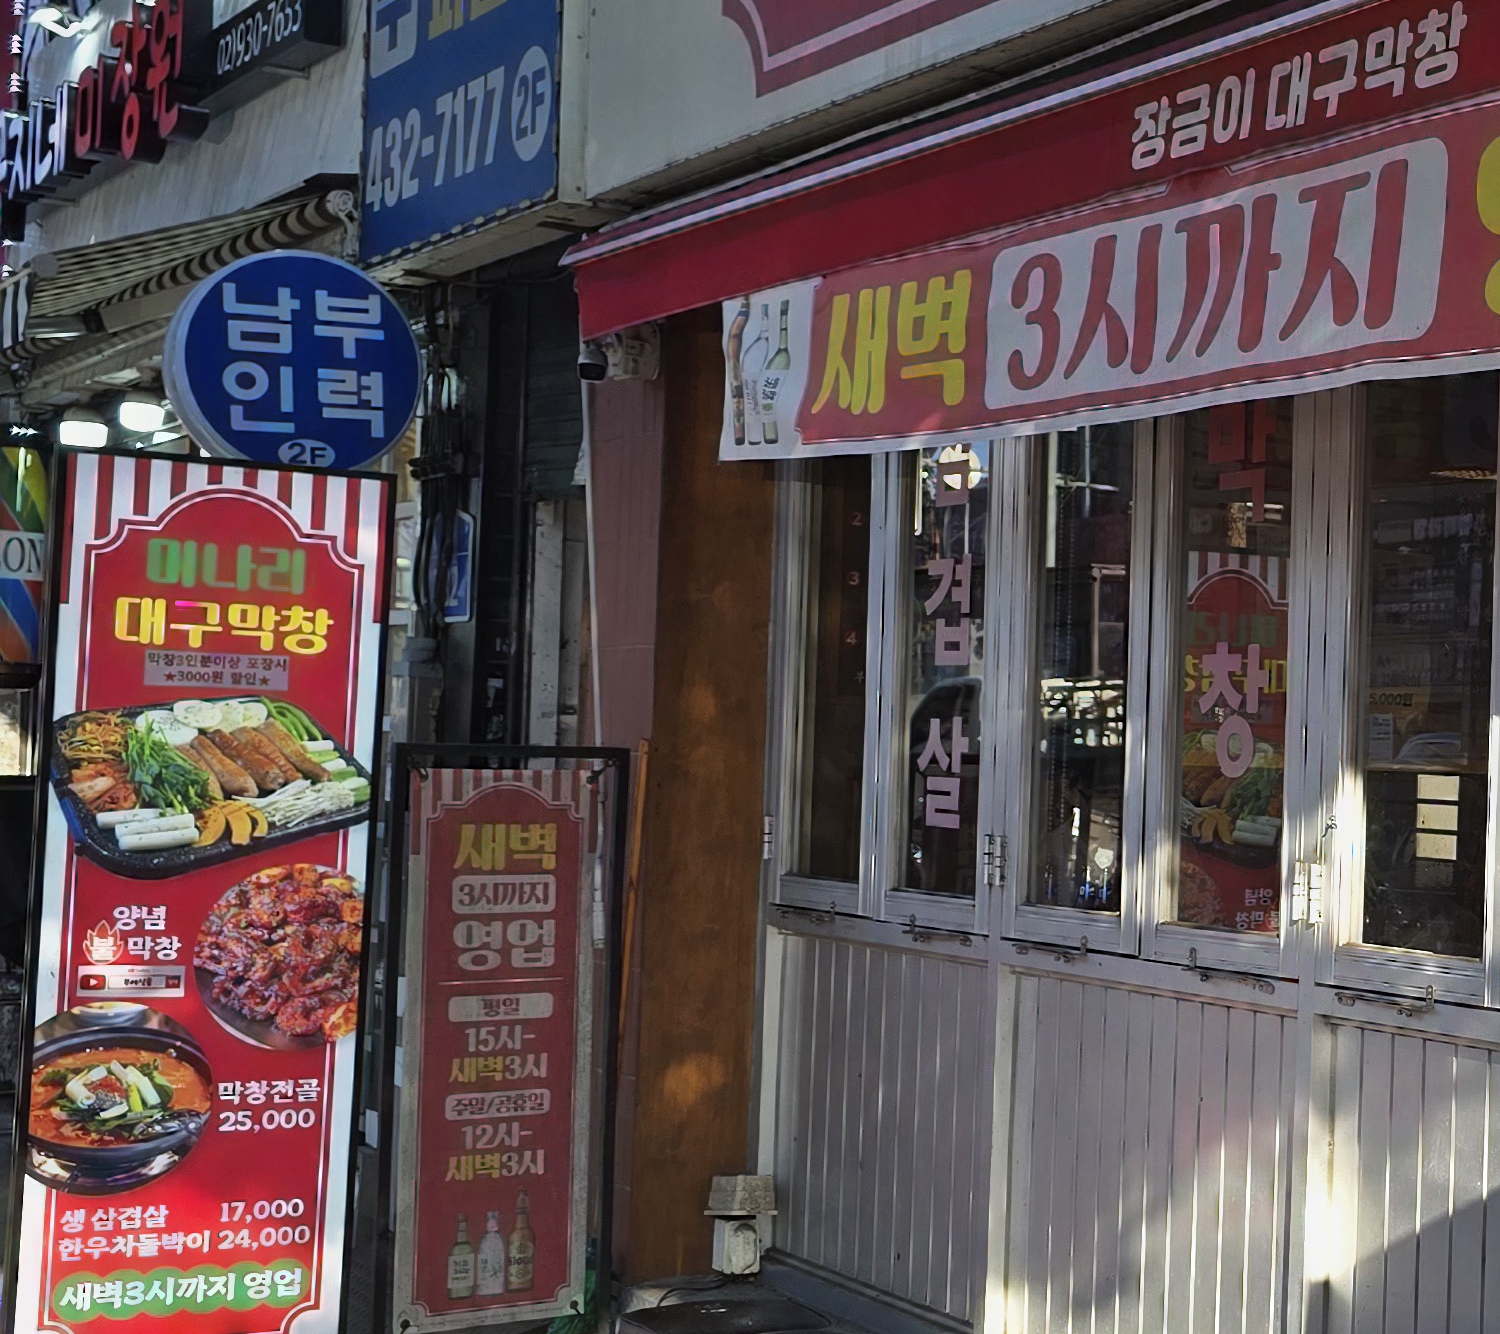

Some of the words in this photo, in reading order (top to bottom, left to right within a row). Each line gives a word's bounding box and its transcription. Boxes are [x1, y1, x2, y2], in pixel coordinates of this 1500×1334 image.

[1130, 67, 1256, 171] 장금이
[1265, 0, 1468, 131] 대구막창
[363, 65, 505, 213] 432-7177
[513, 68, 549, 140] 2F
[810, 268, 973, 416] 새벽
[1004, 156, 1411, 393] 3시까지
[222, 281, 386, 359] 남부
[221, 359, 386, 439] 인력
[286, 443, 328, 465] 2F
[146, 537, 308, 596] 미나리
[114, 595, 335, 656] 대구막창
[177, 670, 225, 685] 3000원
[230, 671, 258, 687] 할인
[453, 822, 557, 871] 새벽
[458, 881, 550, 907] 3시까지
[112, 905, 166, 931] 양념
[88, 936, 119, 960] 불
[126, 935, 182, 961] 막창
[452, 919, 556, 971] 영업
[481, 996, 521, 1017] 평일
[465, 1024, 537, 1052] 15시-
[448, 1052, 549, 1084] 새벽3시
[217, 1078, 321, 1105] 막창전골
[450, 1092, 546, 1117] 주말/공휴일
[217, 1108, 316, 1133] 25,000
[460, 1121, 534, 1151] 12시-
[445, 1149, 545, 1182] 새벽3시
[219, 1198, 305, 1223] 17,000
[58, 1230, 210, 1262] 한우차돌박이
[217, 1225, 311, 1251] 24,000
[59, 1272, 236, 1312] 새벽3시까지
[243, 1267, 304, 1299] 영업
